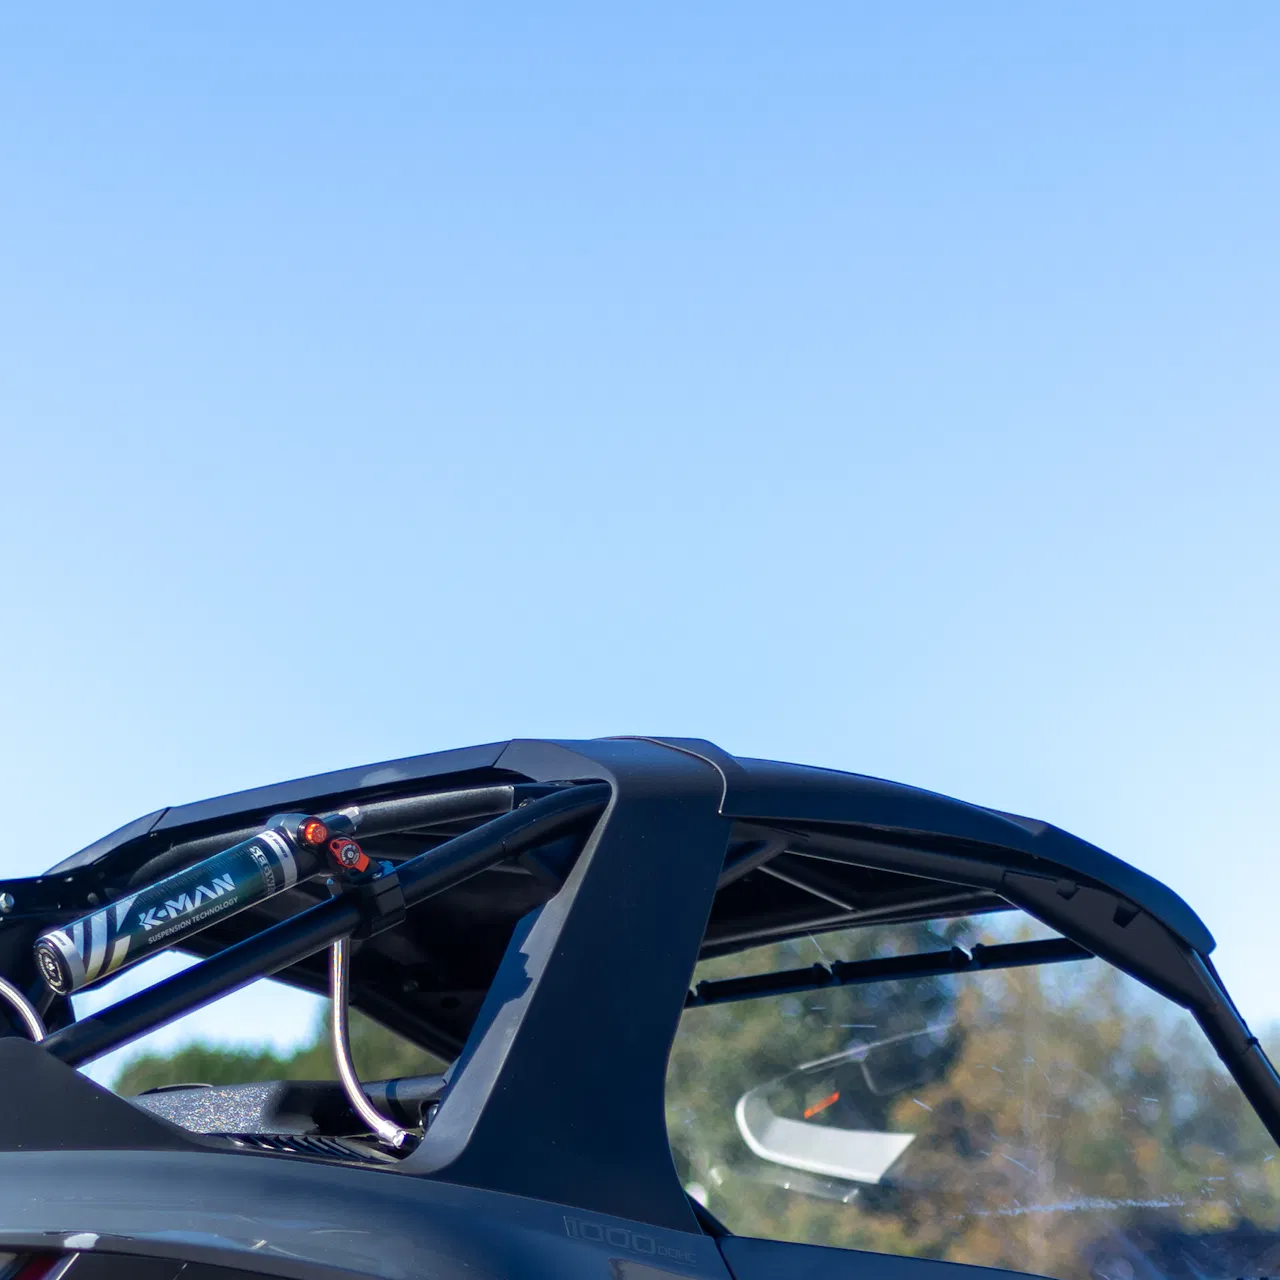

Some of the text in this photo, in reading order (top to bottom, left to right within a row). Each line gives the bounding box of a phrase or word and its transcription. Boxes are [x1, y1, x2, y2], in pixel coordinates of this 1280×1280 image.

[138, 873, 236, 931] K-MAN
[148, 896, 239, 944] SUSPENSION TECHNOLOGY
[562, 1215, 656, 1256] 1000
